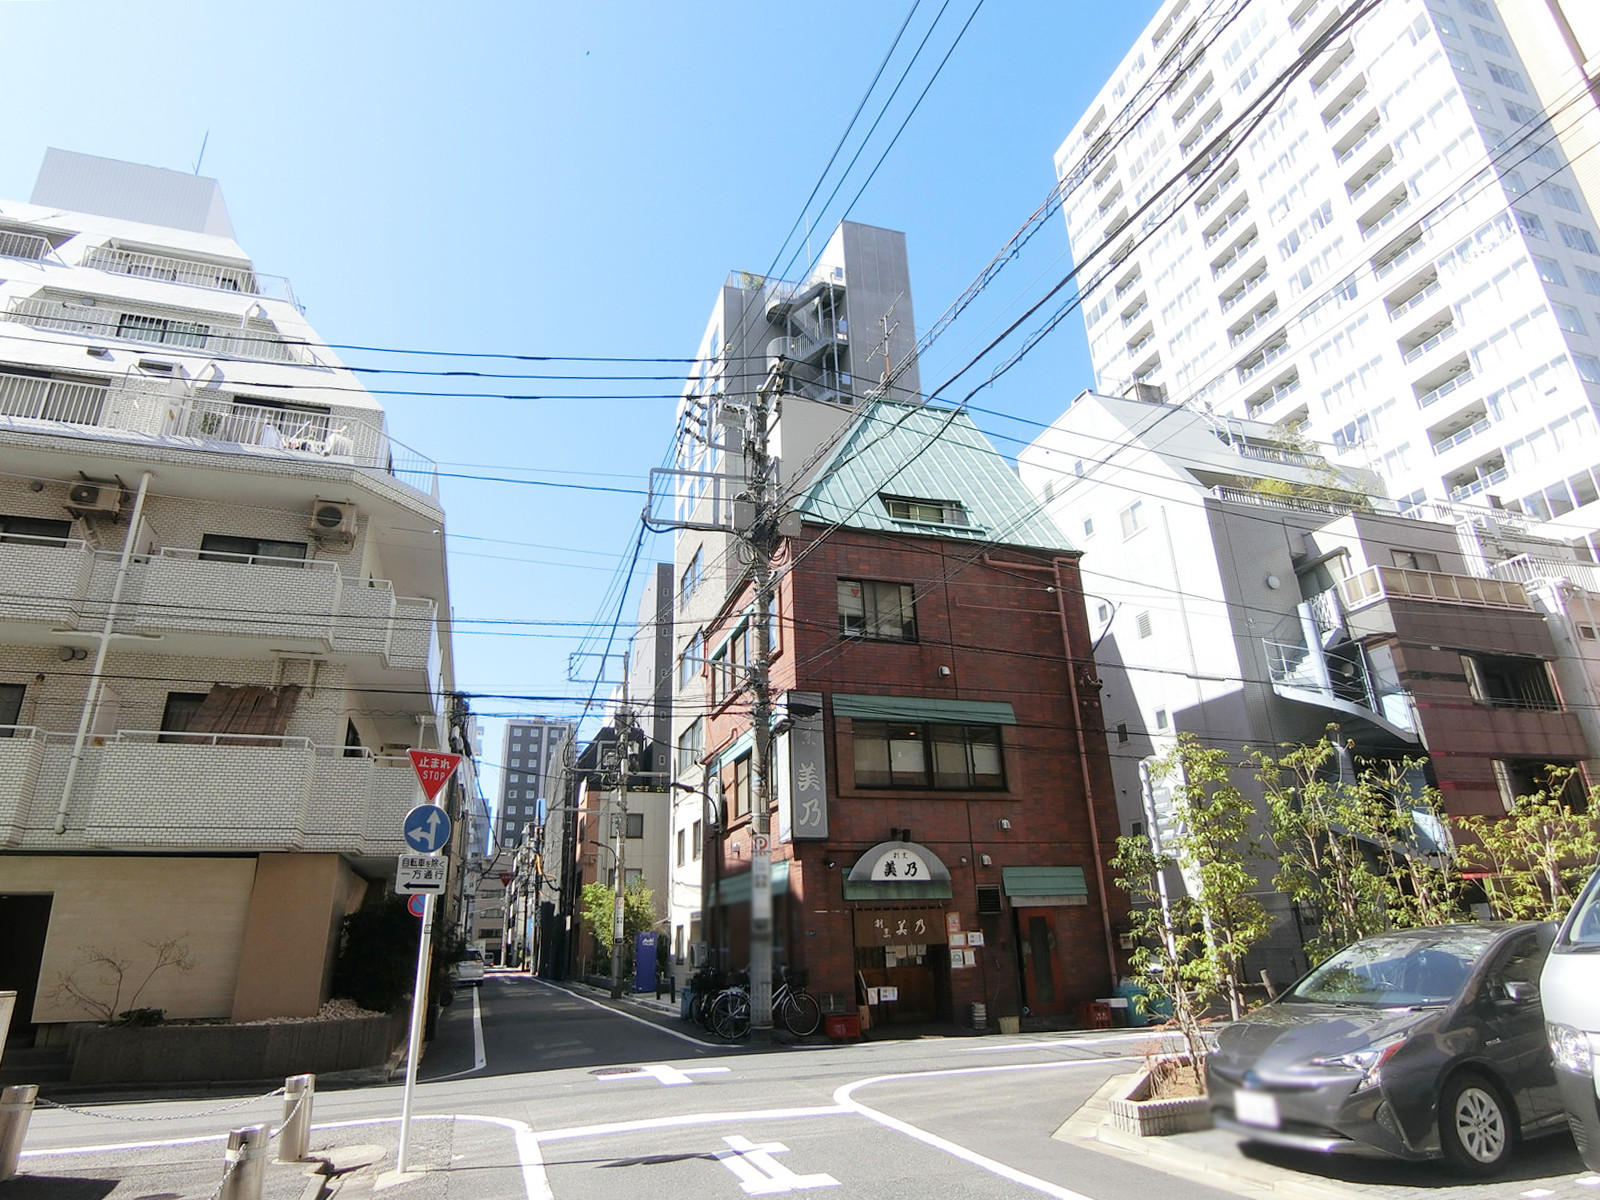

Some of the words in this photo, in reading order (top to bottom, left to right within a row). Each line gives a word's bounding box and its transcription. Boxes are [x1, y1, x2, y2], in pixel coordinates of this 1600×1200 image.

[418, 756, 451, 770] 止まれ
[422, 769, 446, 781] STOP
[401, 857, 445, 868] 自転車を除く
[884, 860, 918, 877] 美乃
[401, 869, 445, 880] 一方通行
